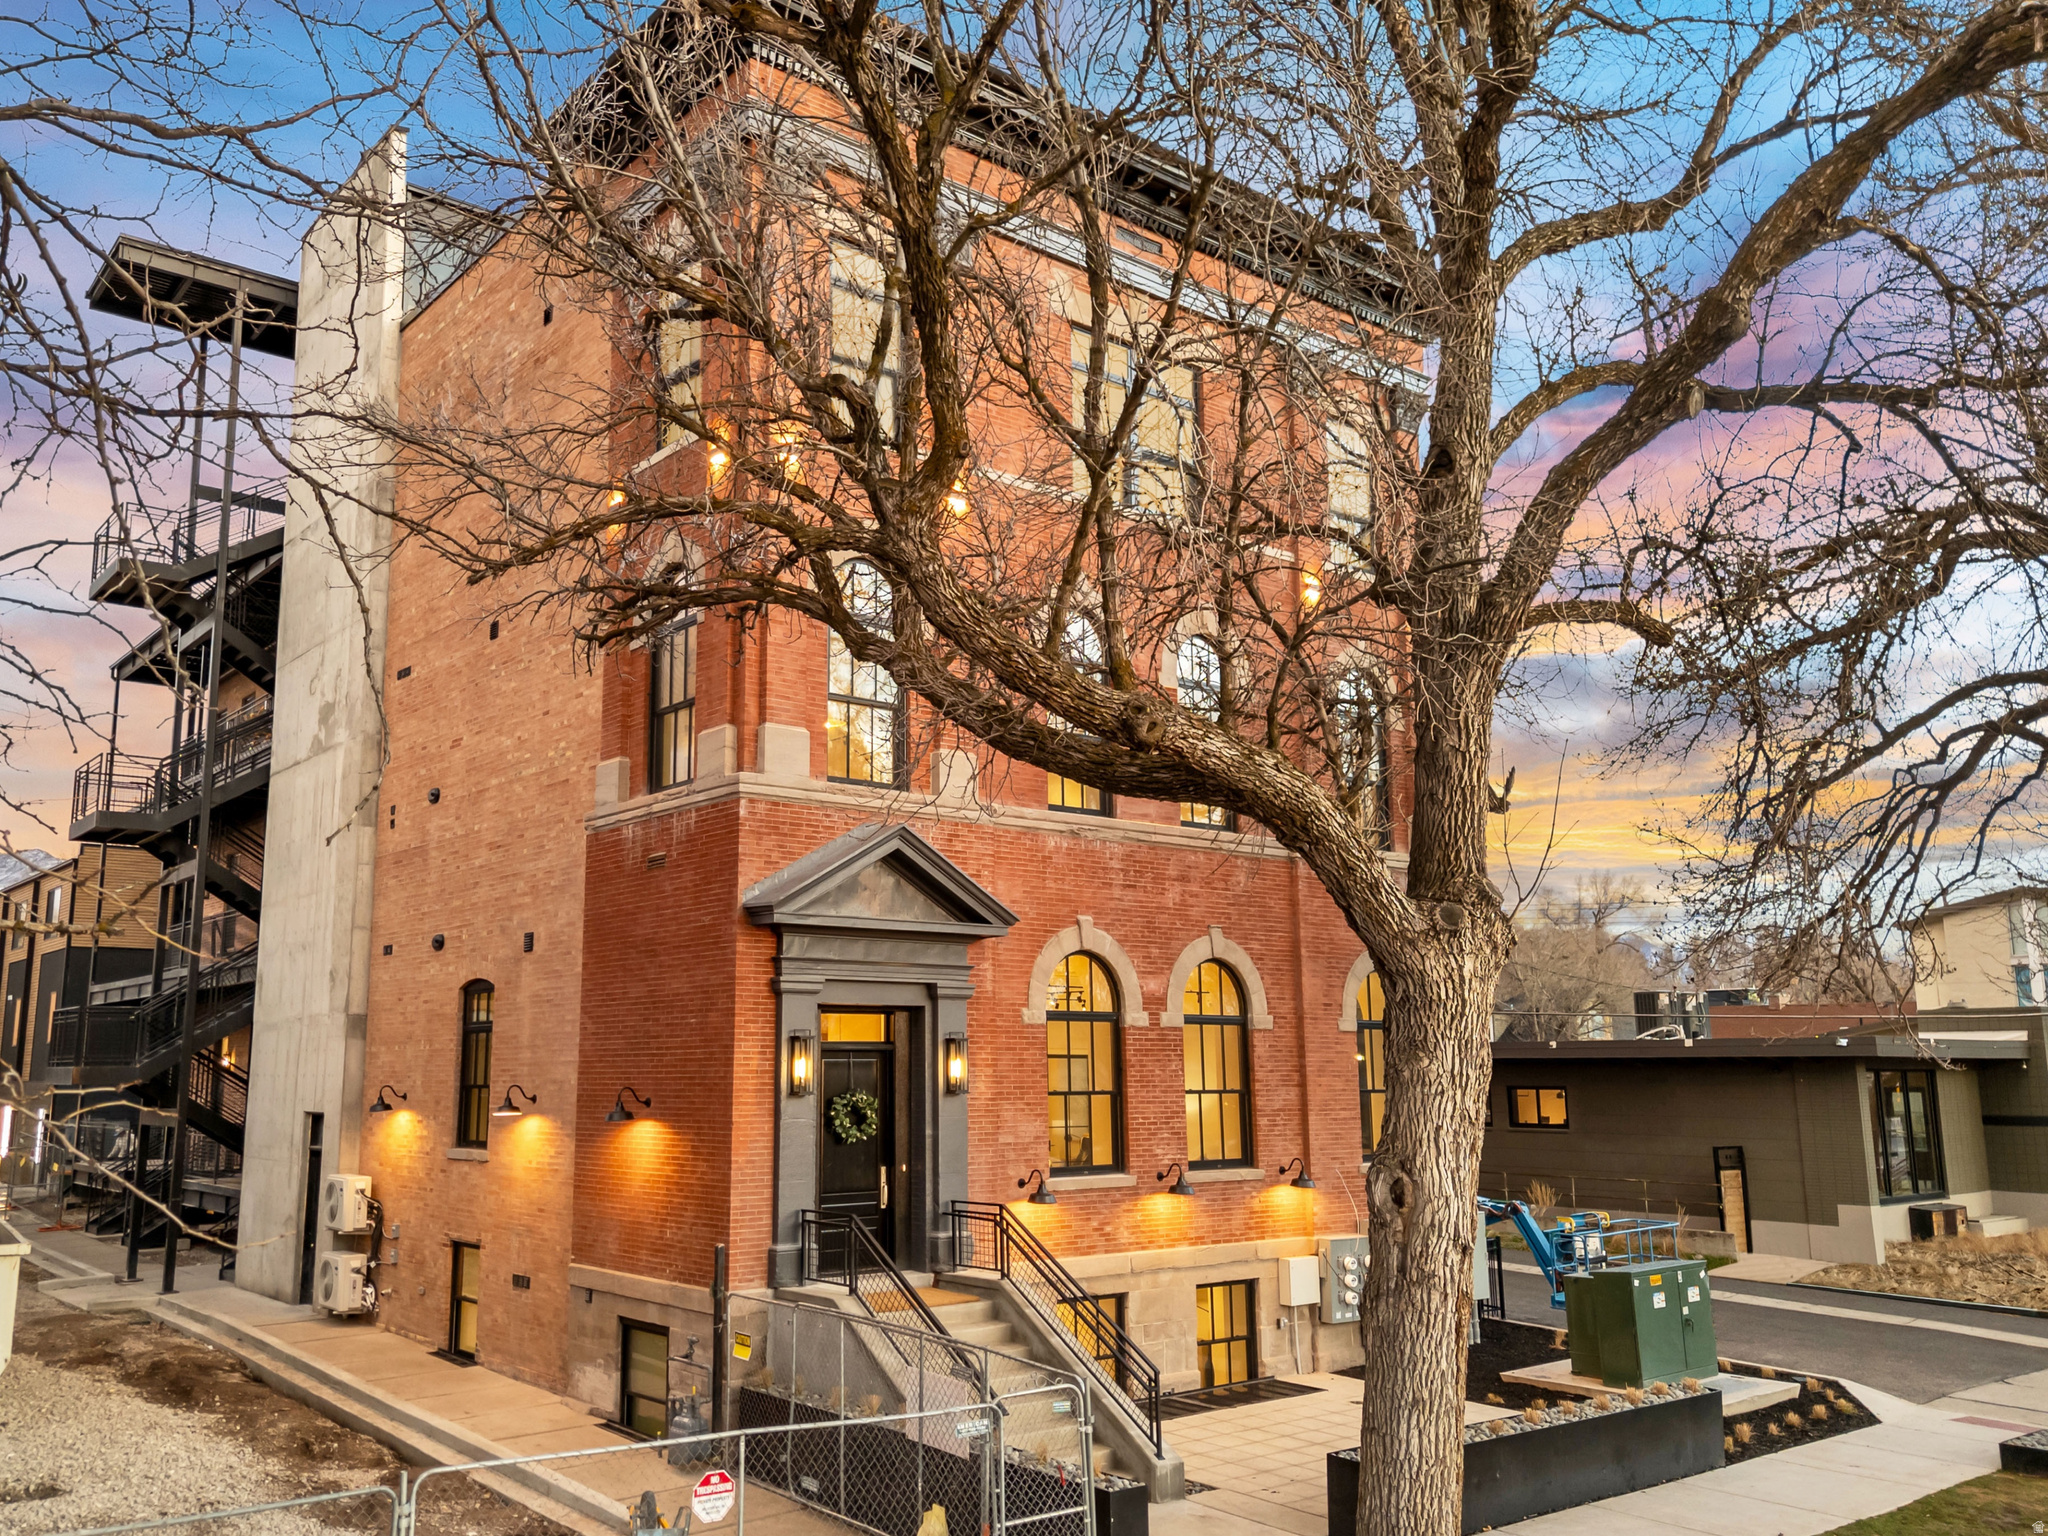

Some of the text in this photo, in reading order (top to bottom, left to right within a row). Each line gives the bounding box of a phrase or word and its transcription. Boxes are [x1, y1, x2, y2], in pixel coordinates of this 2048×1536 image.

[957, 1420, 988, 1430] AMERCAN
[710, 1475, 720, 1484] NO
[697, 1482, 732, 1495] TRESPASSING
